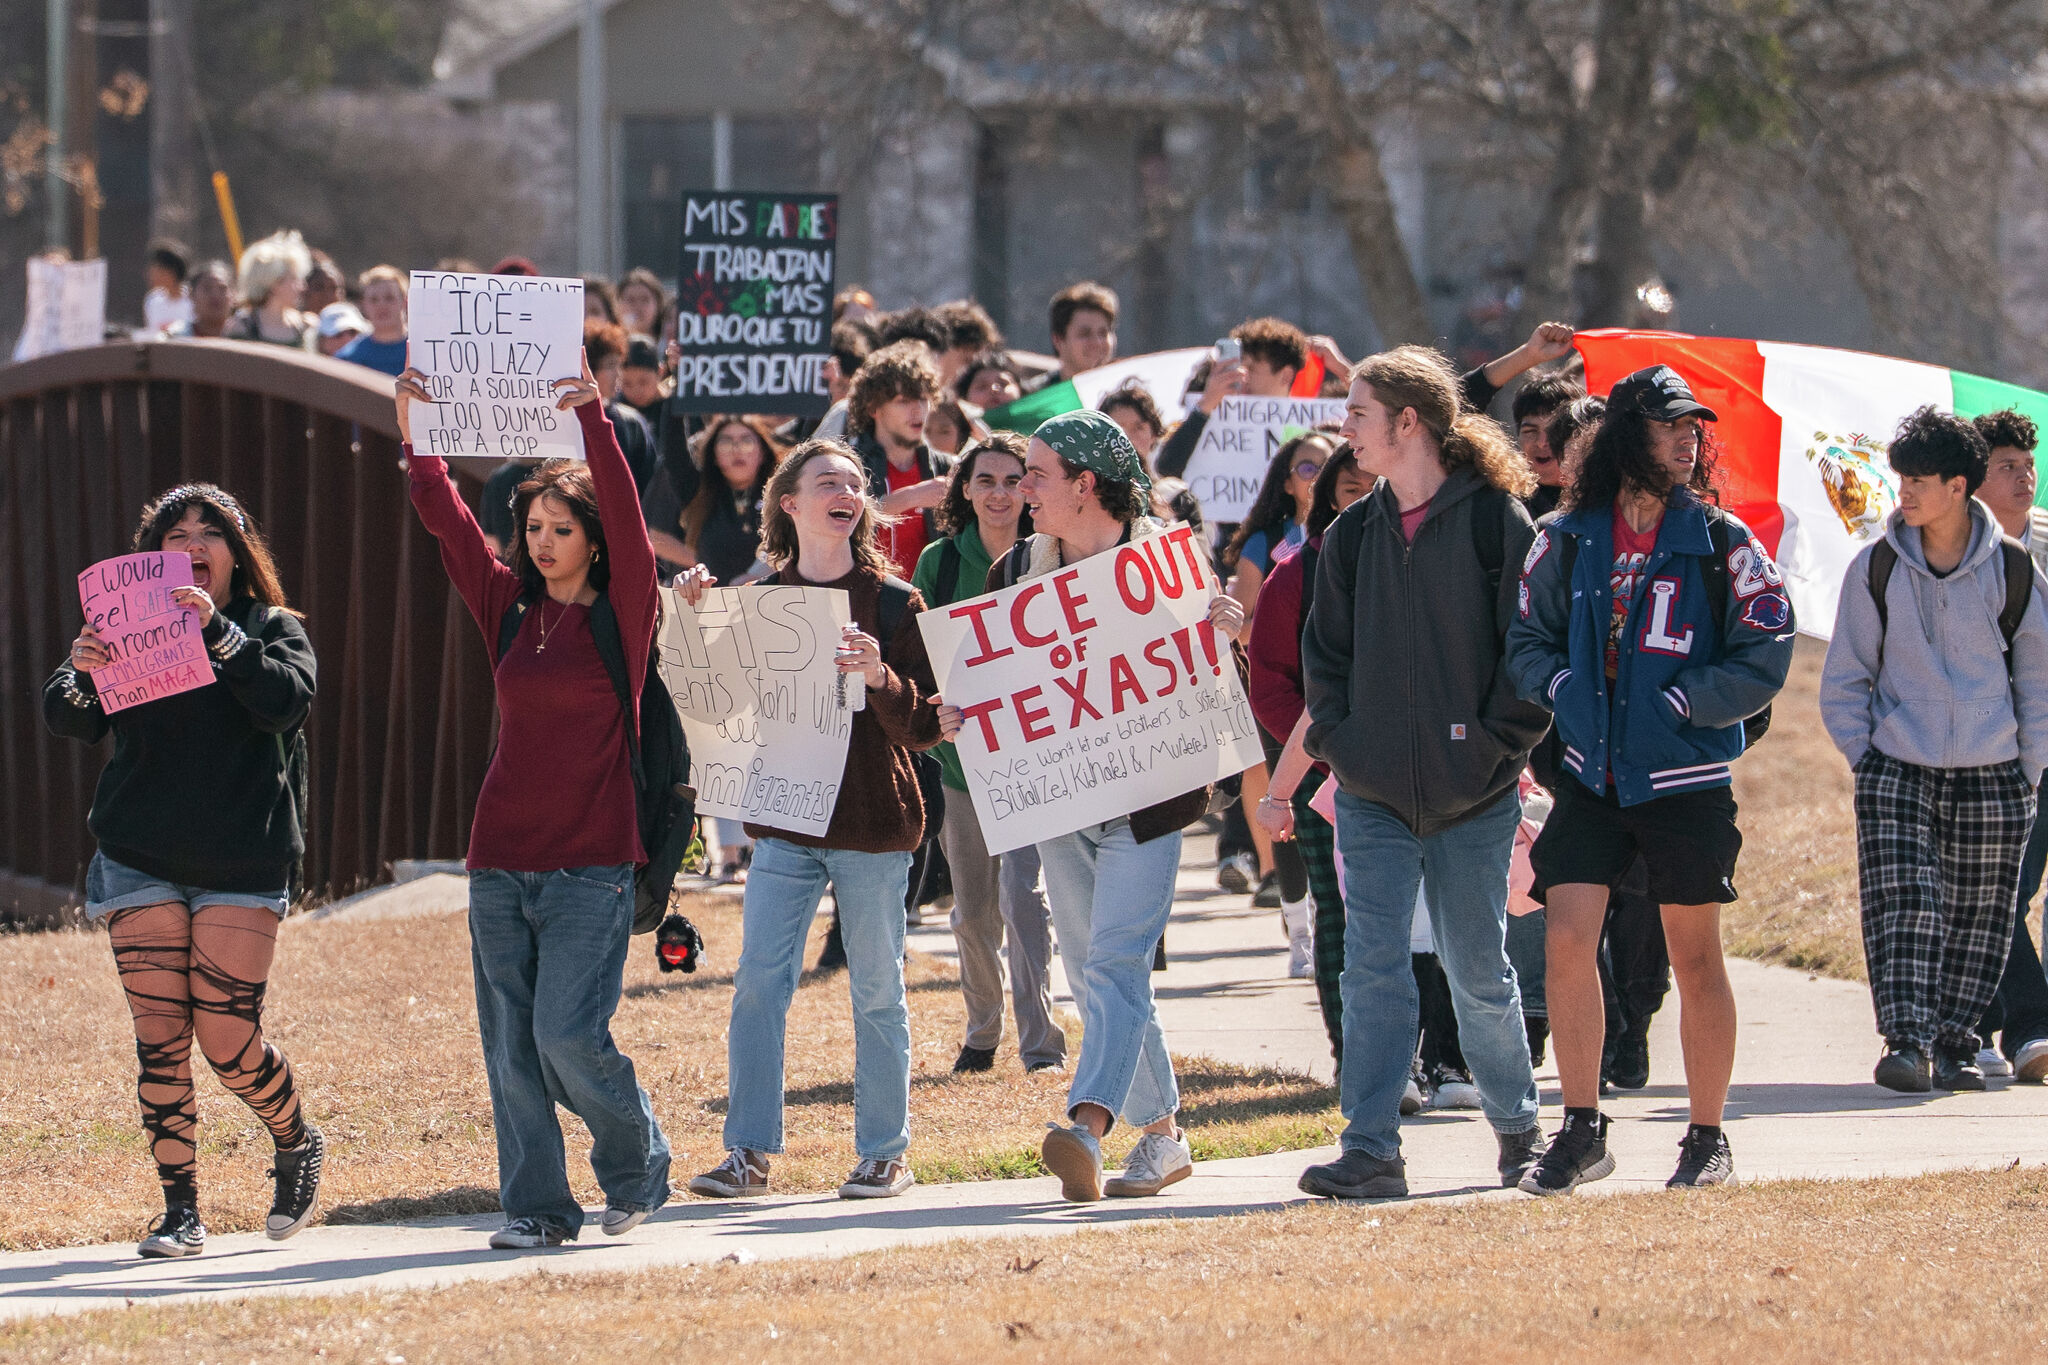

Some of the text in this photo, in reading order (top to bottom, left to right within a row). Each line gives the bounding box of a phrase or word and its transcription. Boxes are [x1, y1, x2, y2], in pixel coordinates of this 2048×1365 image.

[684, 198, 837, 240] MIS PADRES
[684, 244, 832, 283] TRABAJAN
[765, 283, 825, 315] MAS
[789, 317, 822, 345] TU
[424, 340, 551, 375] TOO LAZY
[677, 354, 830, 397] PRESIDENTE
[423, 375, 559, 399] FOR A SOLDIER
[429, 401, 557, 432] TOO DUMB
[429, 428, 538, 456] FOR A COP
[1202, 428, 1254, 452] ARE
[1189, 475, 1259, 503] CRIM
[1729, 538, 1783, 598] 26
[80, 572, 99, 605] I
[134, 586, 177, 621] SAFE
[949, 527, 1205, 668] ICE OUT
[121, 625, 167, 657] room
[169, 611, 191, 639] of
[658, 587, 816, 671] HS
[1644, 580, 1694, 656] L
[93, 641, 194, 689] IMMIGRANTS
[1049, 636, 1088, 670] OF
[149, 665, 199, 696] MAGA
[667, 664, 733, 713] ents
[961, 619, 1221, 753] TEXAS!!
[716, 719, 767, 747] all
[974, 757, 1030, 785] We
[1094, 732, 1111, 747] our
[1117, 707, 1171, 740] brothers
[1178, 700, 1190, 719] &
[1229, 682, 1243, 702] be
[1130, 746, 1146, 773] &
[1210, 719, 1226, 746] by
[1222, 701, 1255, 741] ICE
[690, 758, 836, 822] migrants
